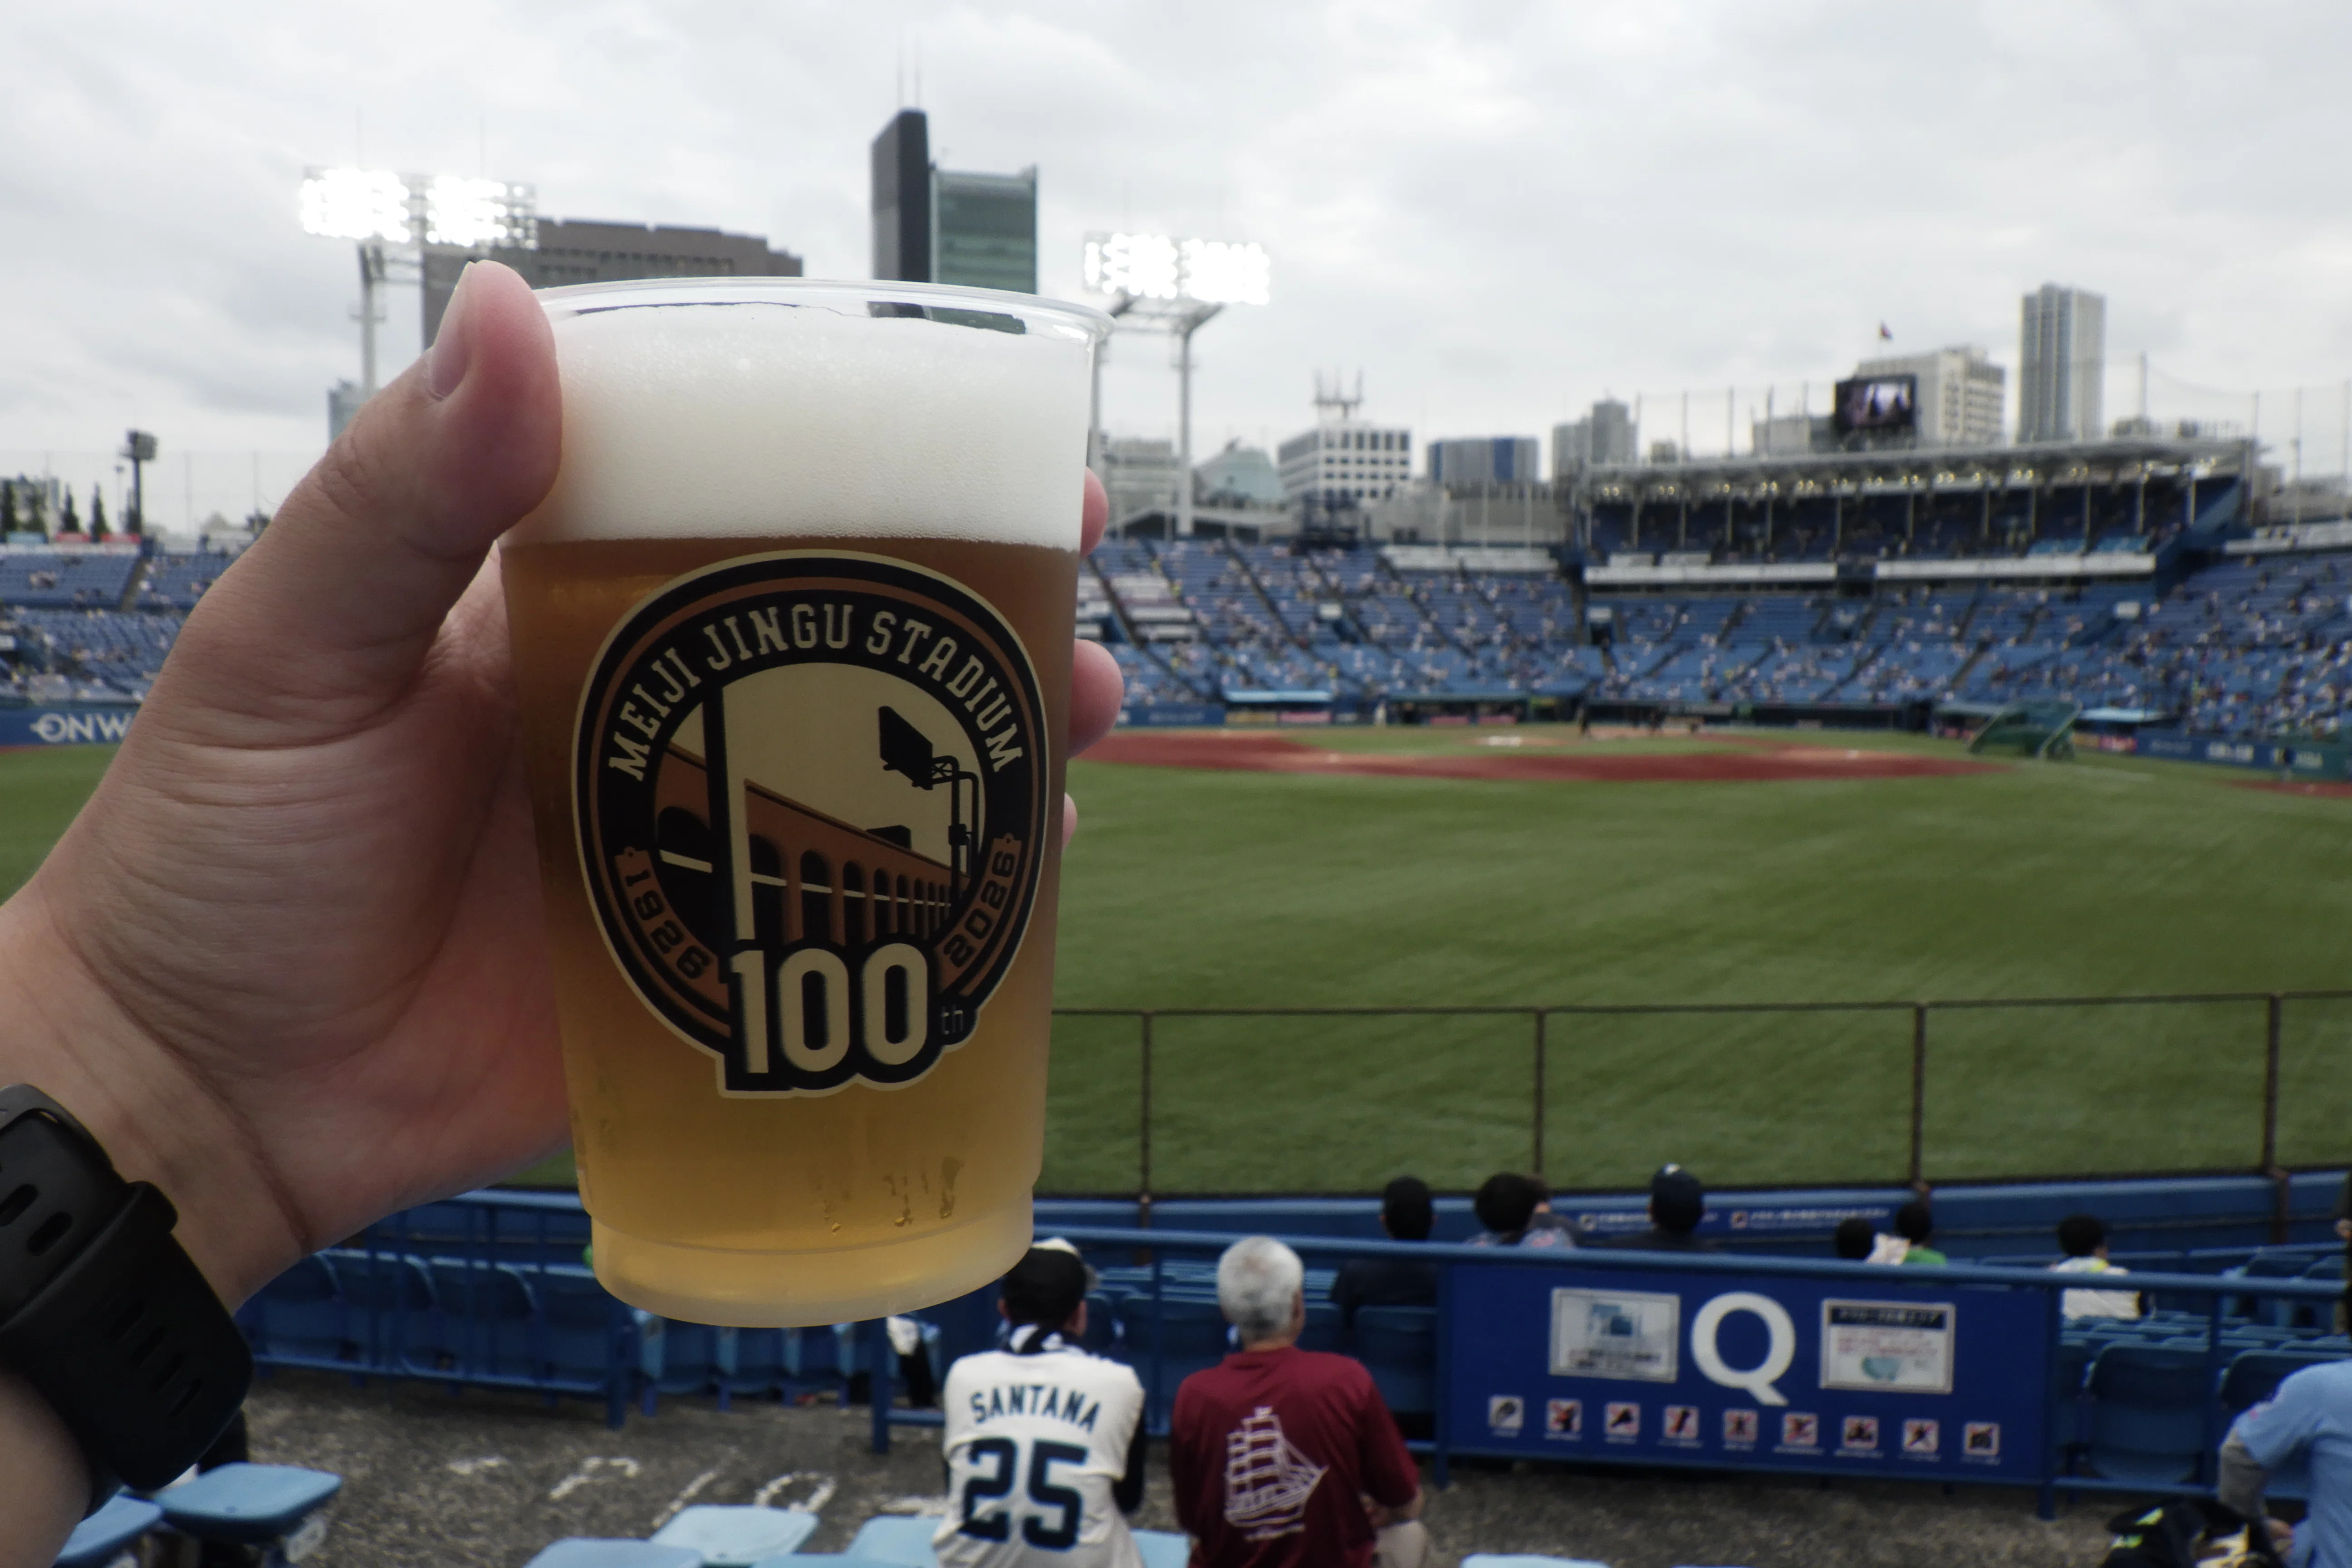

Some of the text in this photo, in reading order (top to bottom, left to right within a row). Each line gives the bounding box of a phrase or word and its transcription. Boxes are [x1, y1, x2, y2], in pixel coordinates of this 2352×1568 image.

[609, 603, 1024, 781] MEIJI JINGU STADIUM
[623, 868, 712, 980] 1926
[943, 852, 1015, 964] 2026
[1690, 1291, 1797, 1406] Q
[970, 1385, 1101, 1431] SANTANA
[958, 1436, 1088, 1551] 25
